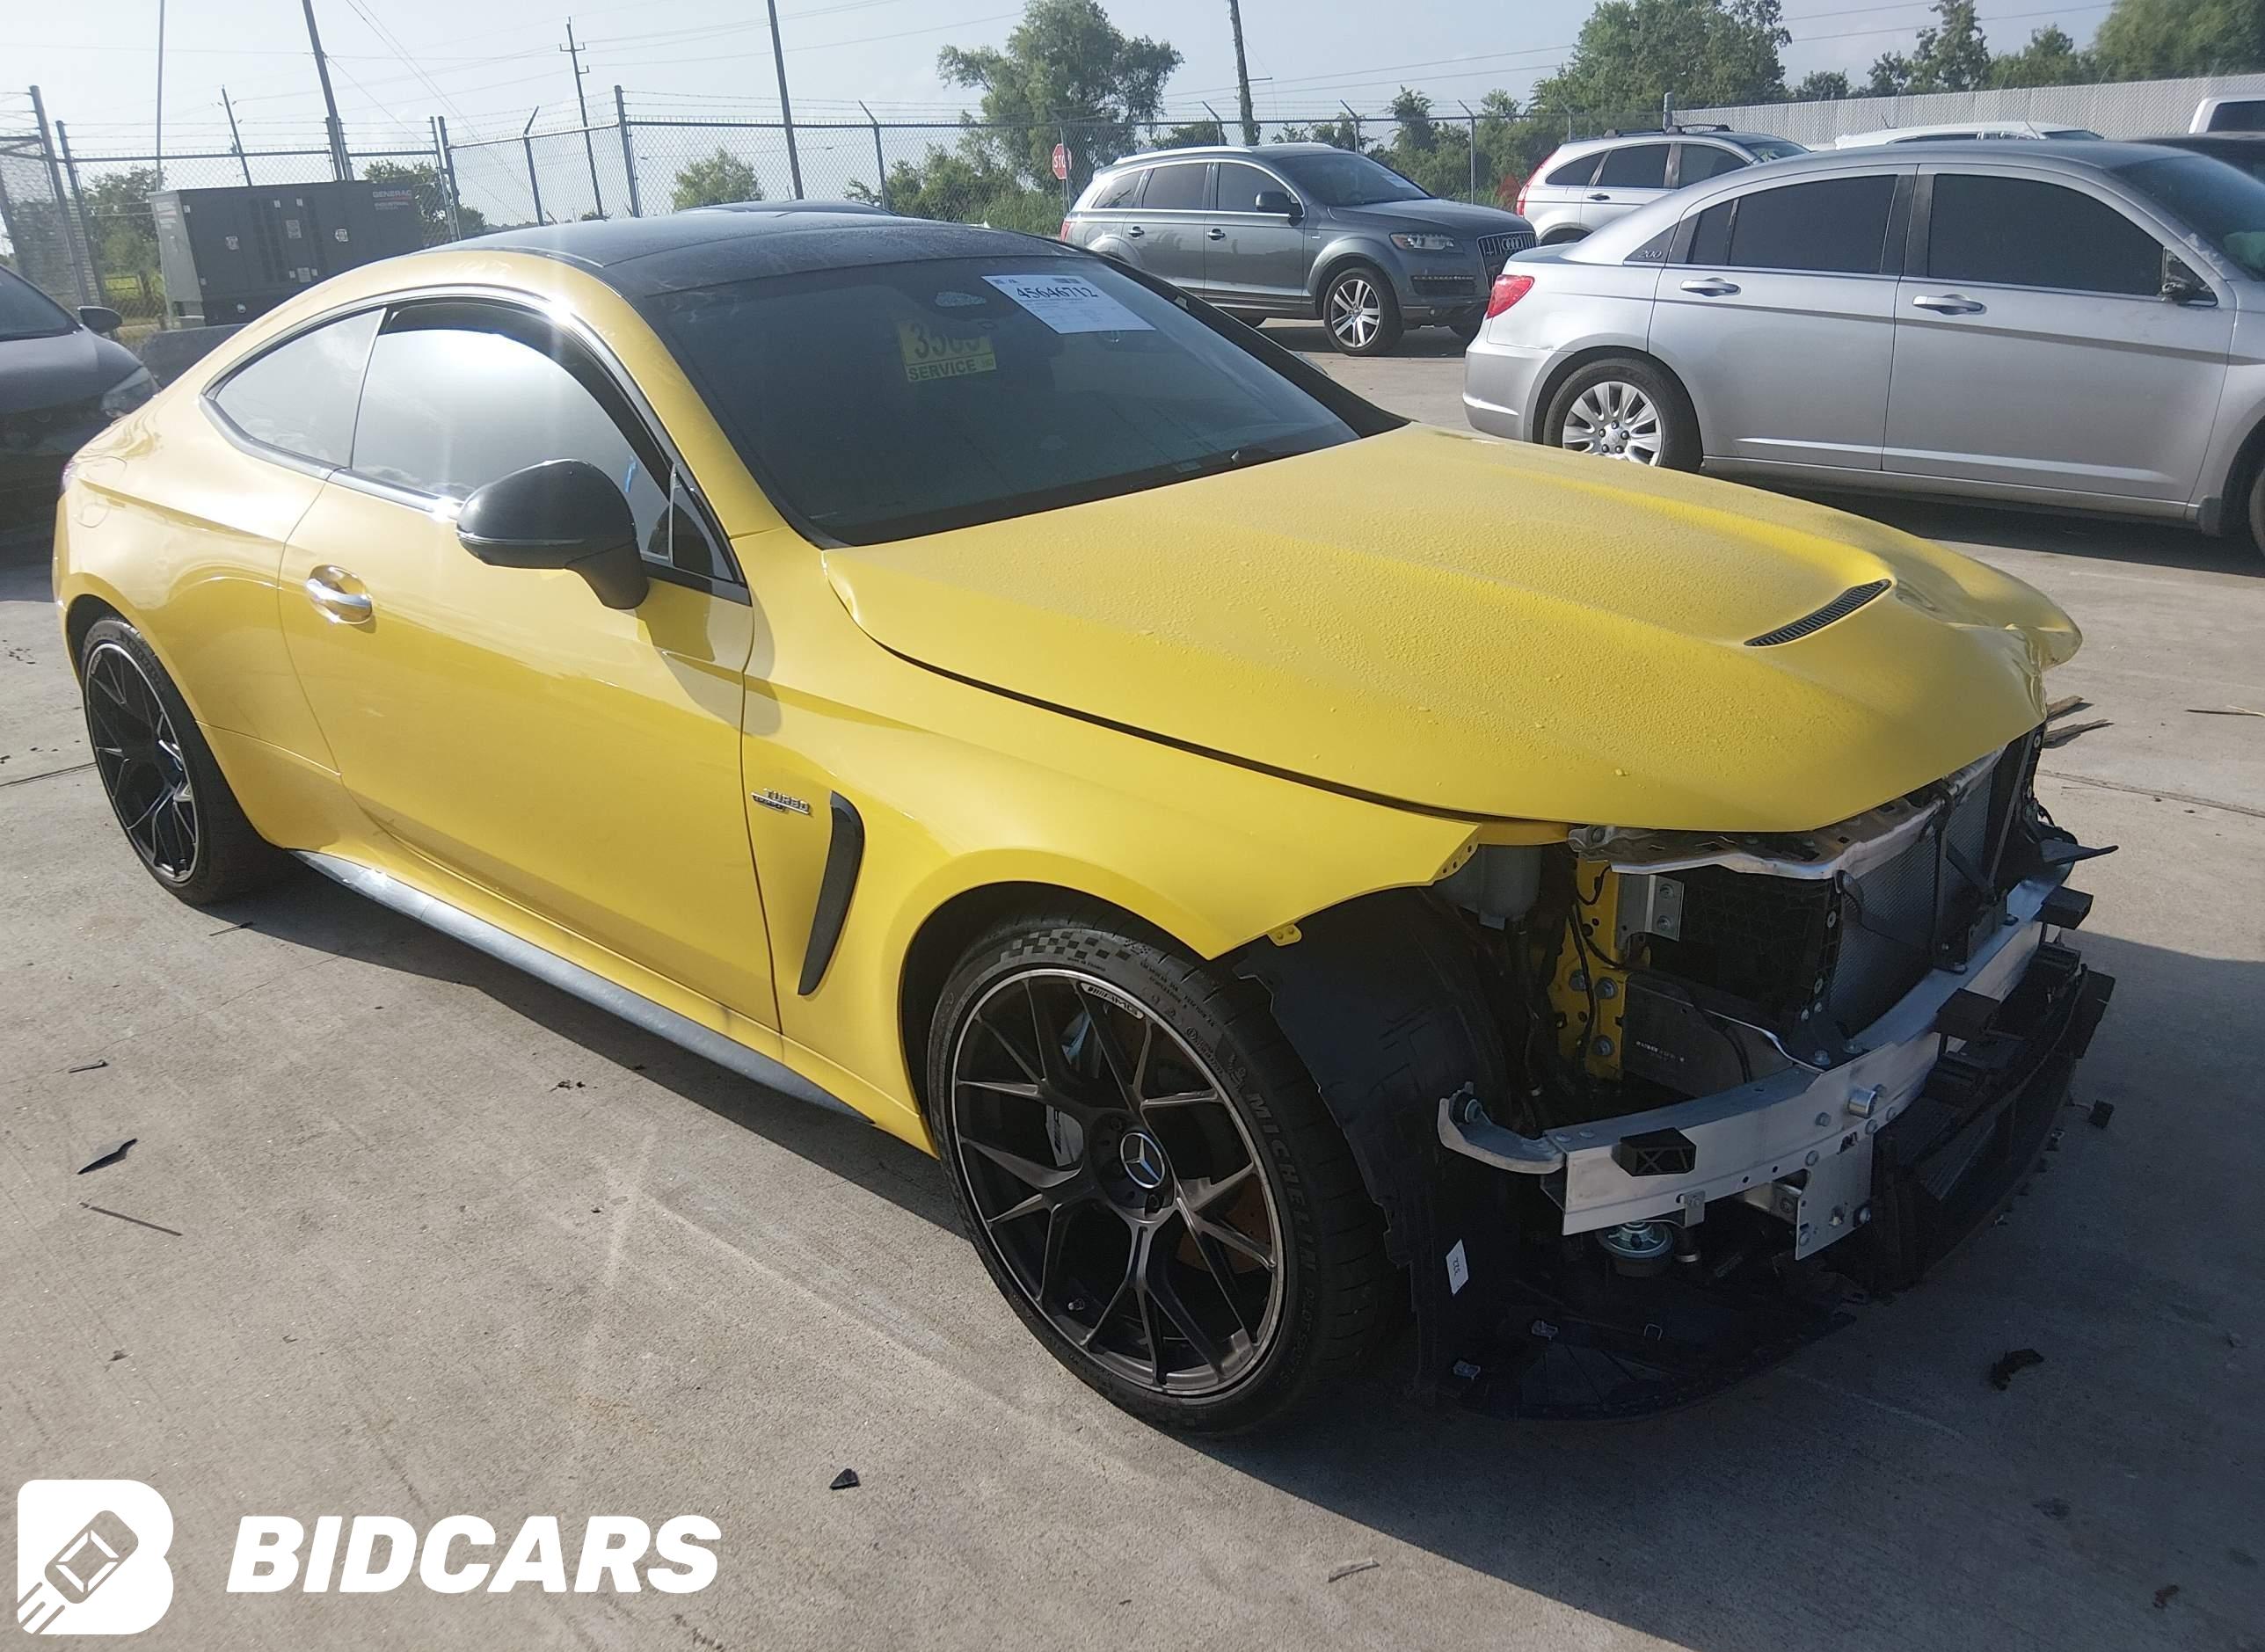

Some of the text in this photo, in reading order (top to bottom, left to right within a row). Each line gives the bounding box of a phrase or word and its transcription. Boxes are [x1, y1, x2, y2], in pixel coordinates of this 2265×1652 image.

[372, 189, 412, 198] GENERAC
[1016, 287, 1098, 299] 45646712
[908, 359, 976, 381] SERVICE
[1246, 1093, 1318, 1272] MICHELIN
